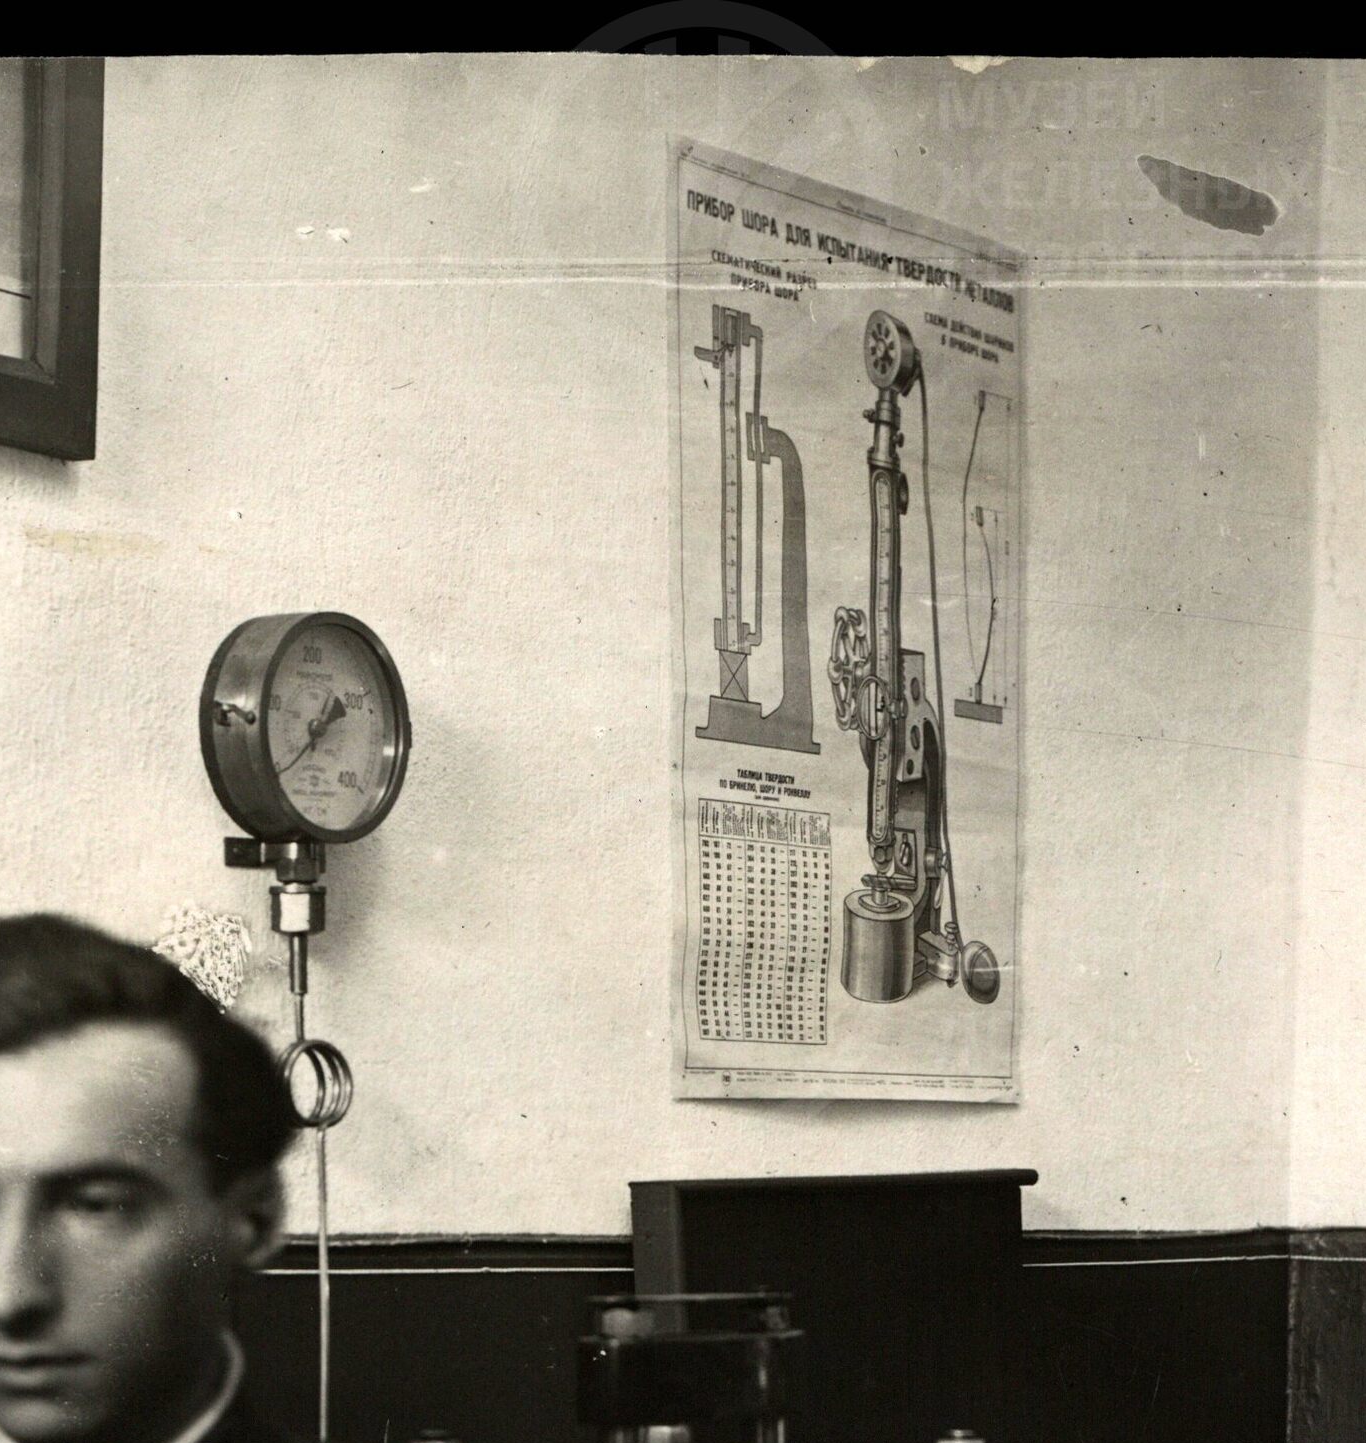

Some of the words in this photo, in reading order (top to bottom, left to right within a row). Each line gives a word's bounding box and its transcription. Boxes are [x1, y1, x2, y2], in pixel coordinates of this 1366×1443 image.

[687, 189, 735, 223] ПРИБОР
[741, 208, 779, 238] ШОРА
[785, 222, 812, 248] ДЛЯ
[817, 232, 890, 273] ИСПЫТАНИЯ
[711, 249, 782, 279] СХЕМАТИЧЕСКИЙ
[731, 272, 772, 295] ПРИБОРА
[774, 286, 800, 302] ШОРА
[303, 645, 322, 665] 200
[344, 692, 363, 711] 300
[337, 771, 357, 788] 400
[737, 768, 763, 781] ТАБЛИЦА
[765, 771, 795, 785] ТВЕРДОСТИ
